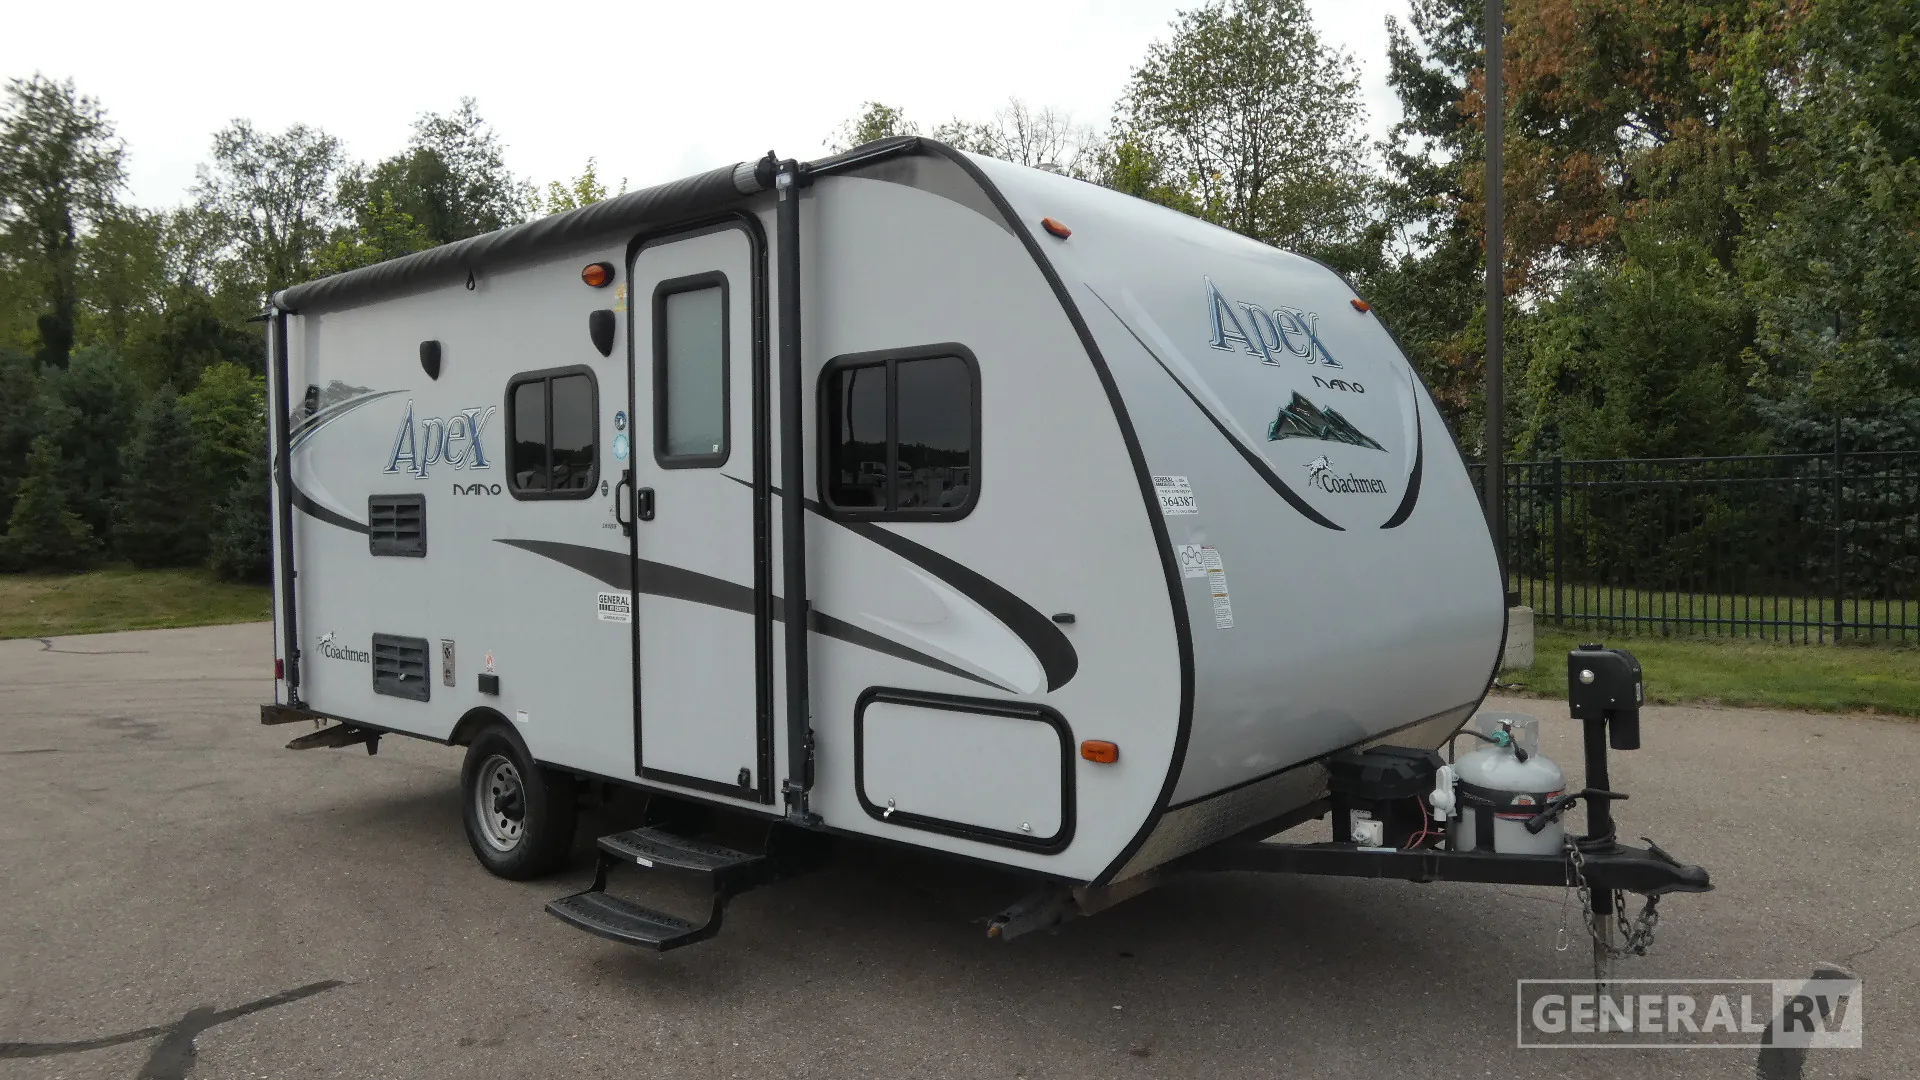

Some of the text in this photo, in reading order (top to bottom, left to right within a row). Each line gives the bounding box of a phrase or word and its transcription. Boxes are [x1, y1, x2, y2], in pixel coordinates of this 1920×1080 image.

[1321, 473, 1387, 494] Coachmen
[1161, 496, 1194, 507] 364387
[598, 594, 629, 605] GENERAL
[325, 644, 370, 664] Coachmen
